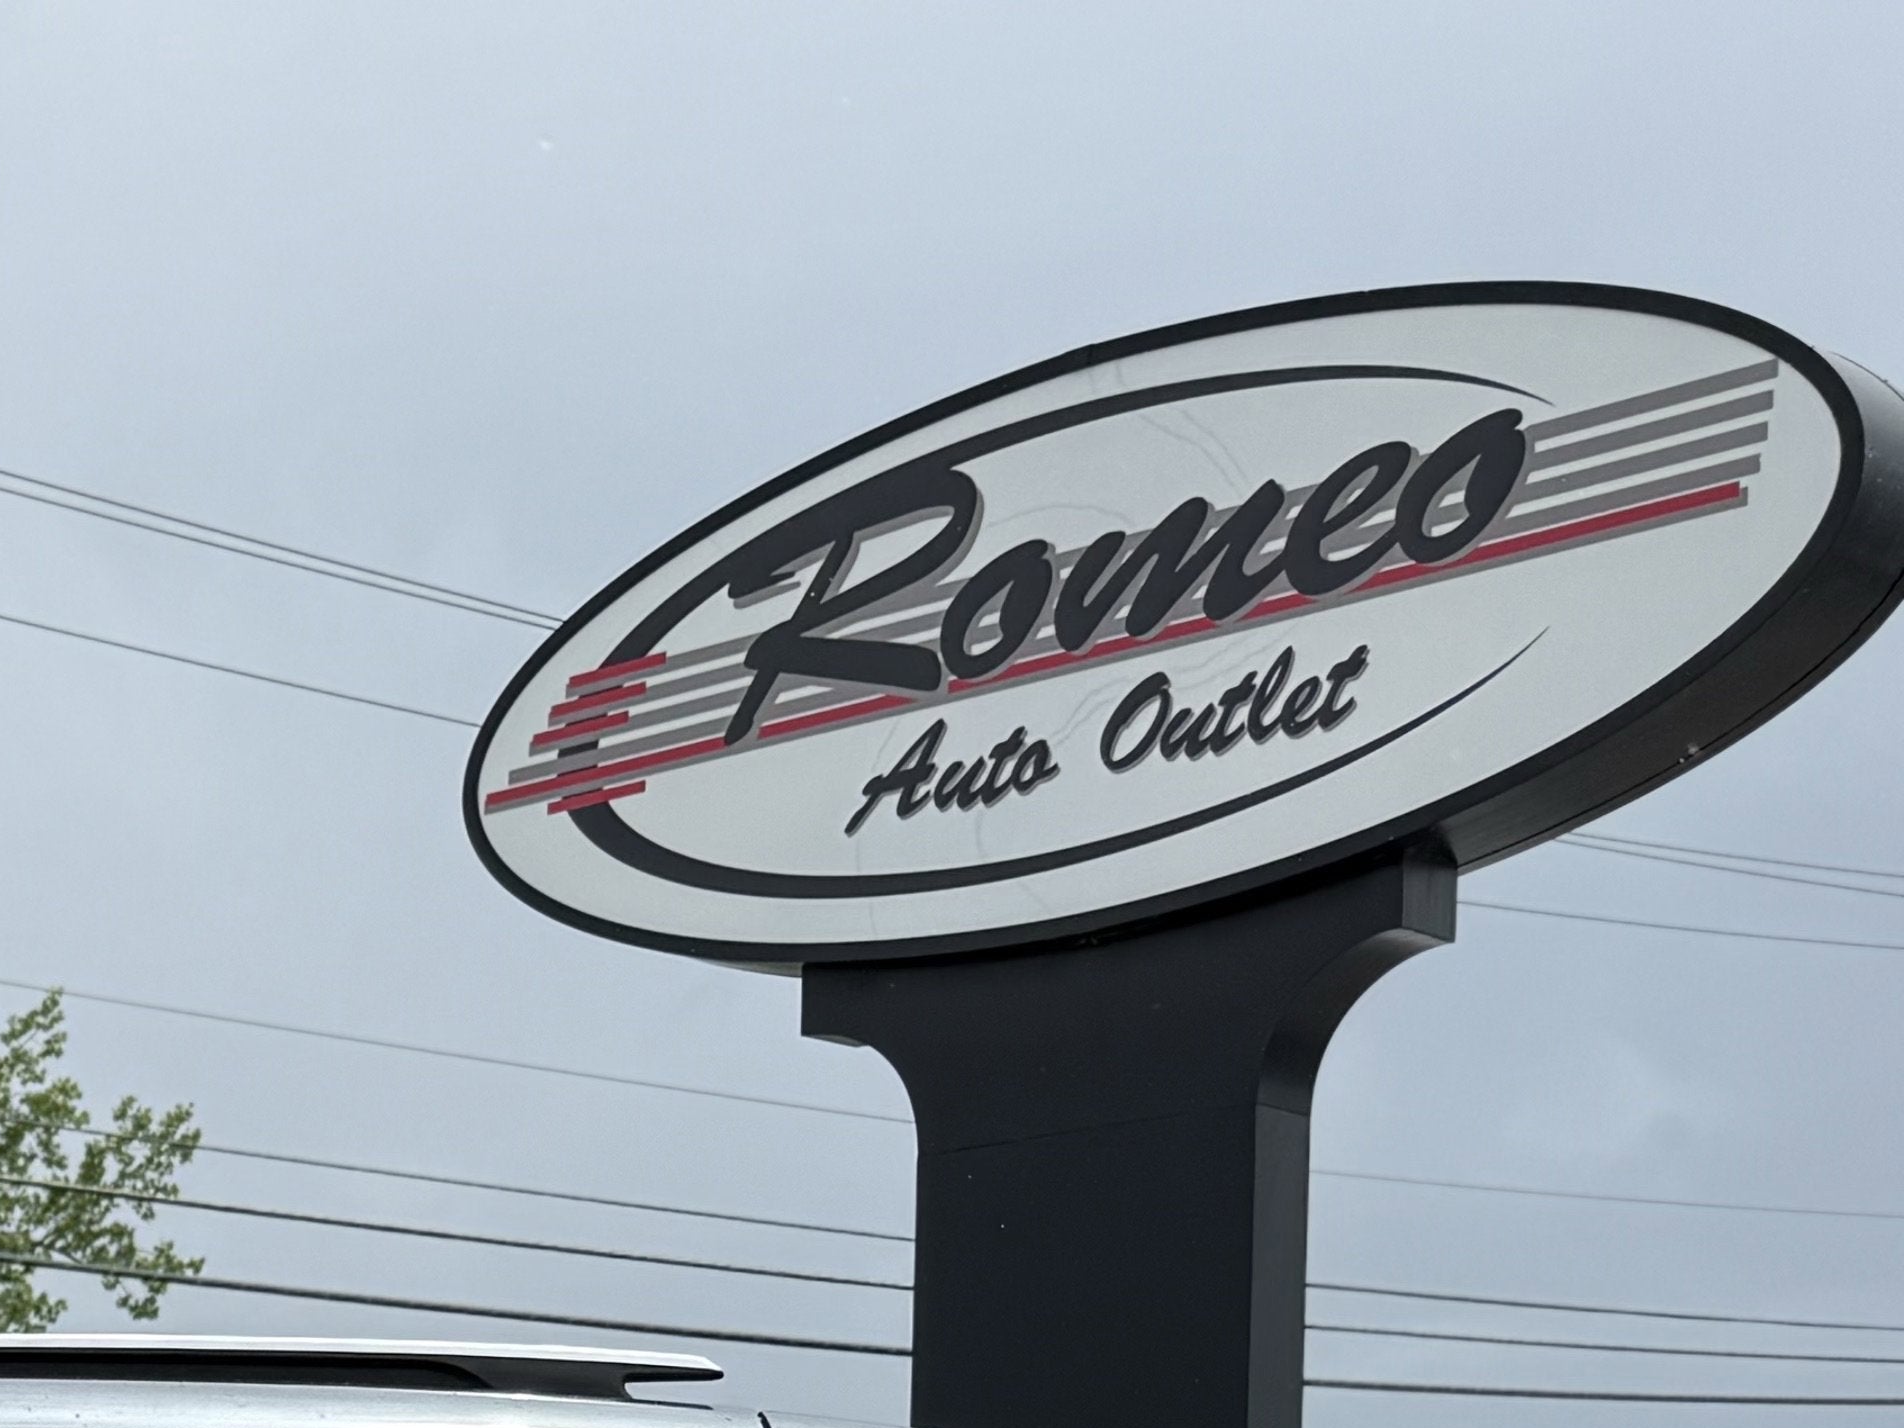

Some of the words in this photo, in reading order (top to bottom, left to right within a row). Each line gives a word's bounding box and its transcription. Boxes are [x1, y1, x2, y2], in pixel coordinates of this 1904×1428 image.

[724, 408, 1528, 746] Romeo
[844, 718, 1059, 836] Auto
[1100, 645, 1370, 773] Outlet
